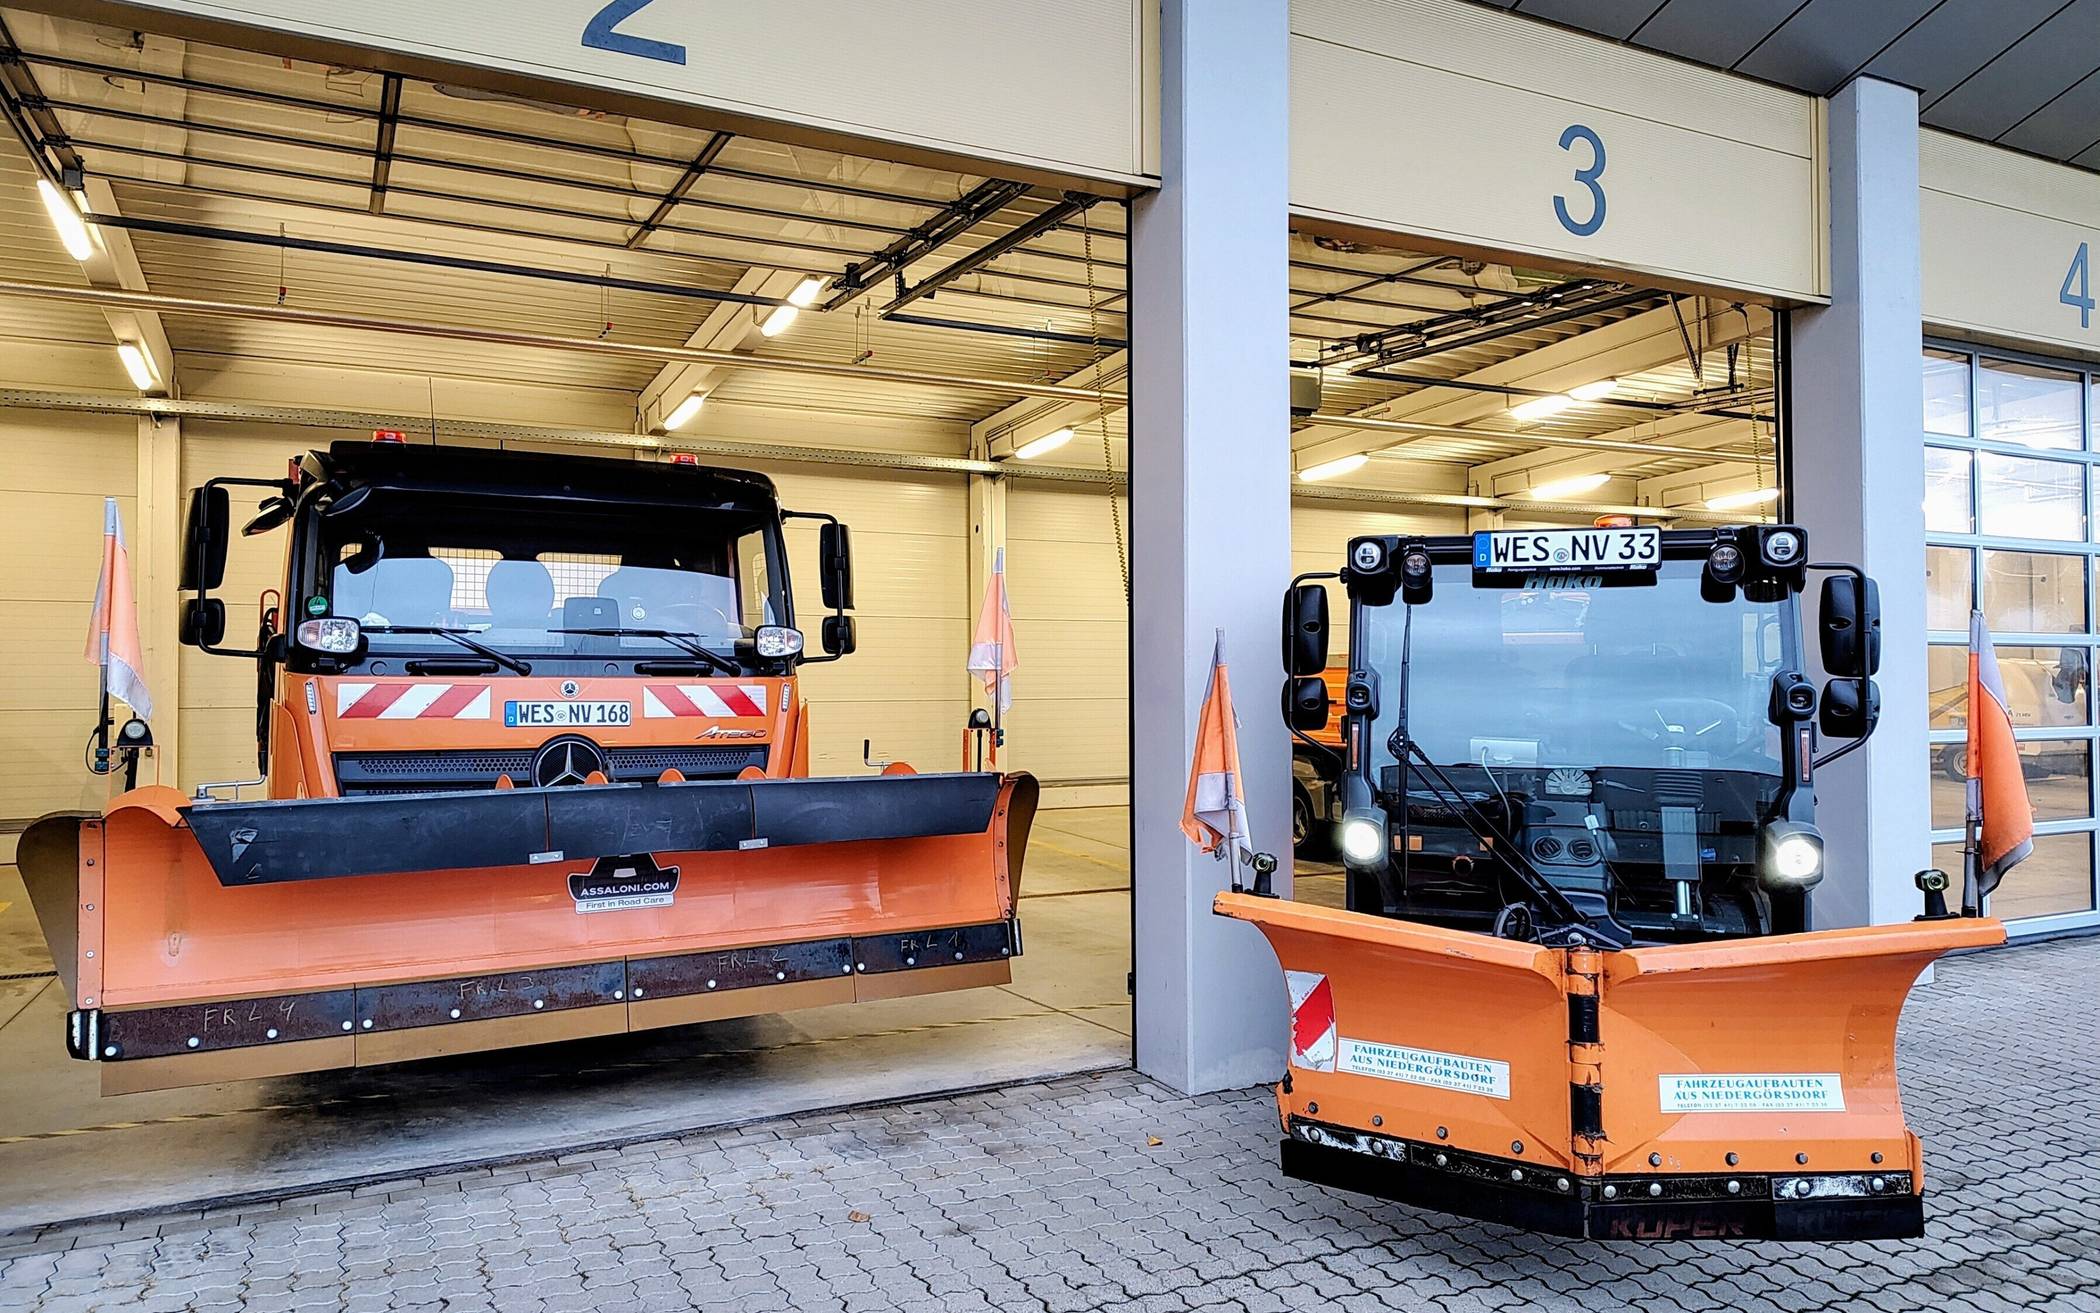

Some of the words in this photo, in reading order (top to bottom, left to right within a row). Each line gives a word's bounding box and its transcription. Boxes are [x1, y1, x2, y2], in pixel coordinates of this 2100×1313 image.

[1553, 124, 1606, 236] 3
[2060, 241, 2095, 328] 4
[1493, 536, 1550, 562] WES
[1571, 534, 1610, 561] NV
[1618, 533, 1656, 560] 33
[519, 704, 554, 723] WES
[569, 704, 592, 723] NV
[596, 704, 629, 723] 168
[580, 881, 670, 897] ASSALONI.COM
[586, 901, 606, 909] First
[618, 898, 641, 906] Road
[1350, 1054, 1373, 1065] AUS
[1377, 1058, 1497, 1085] NIEDERGÖRSDORF
[1354, 1044, 1492, 1074] FAHRZEUGAUFBAUTEN
[1673, 1091, 1697, 1100] AUS
[1702, 1089, 1829, 1100] NIEDERGÖRSDORF
[1676, 1079, 1823, 1088] FAHRZEUGAUFBAUTEN
